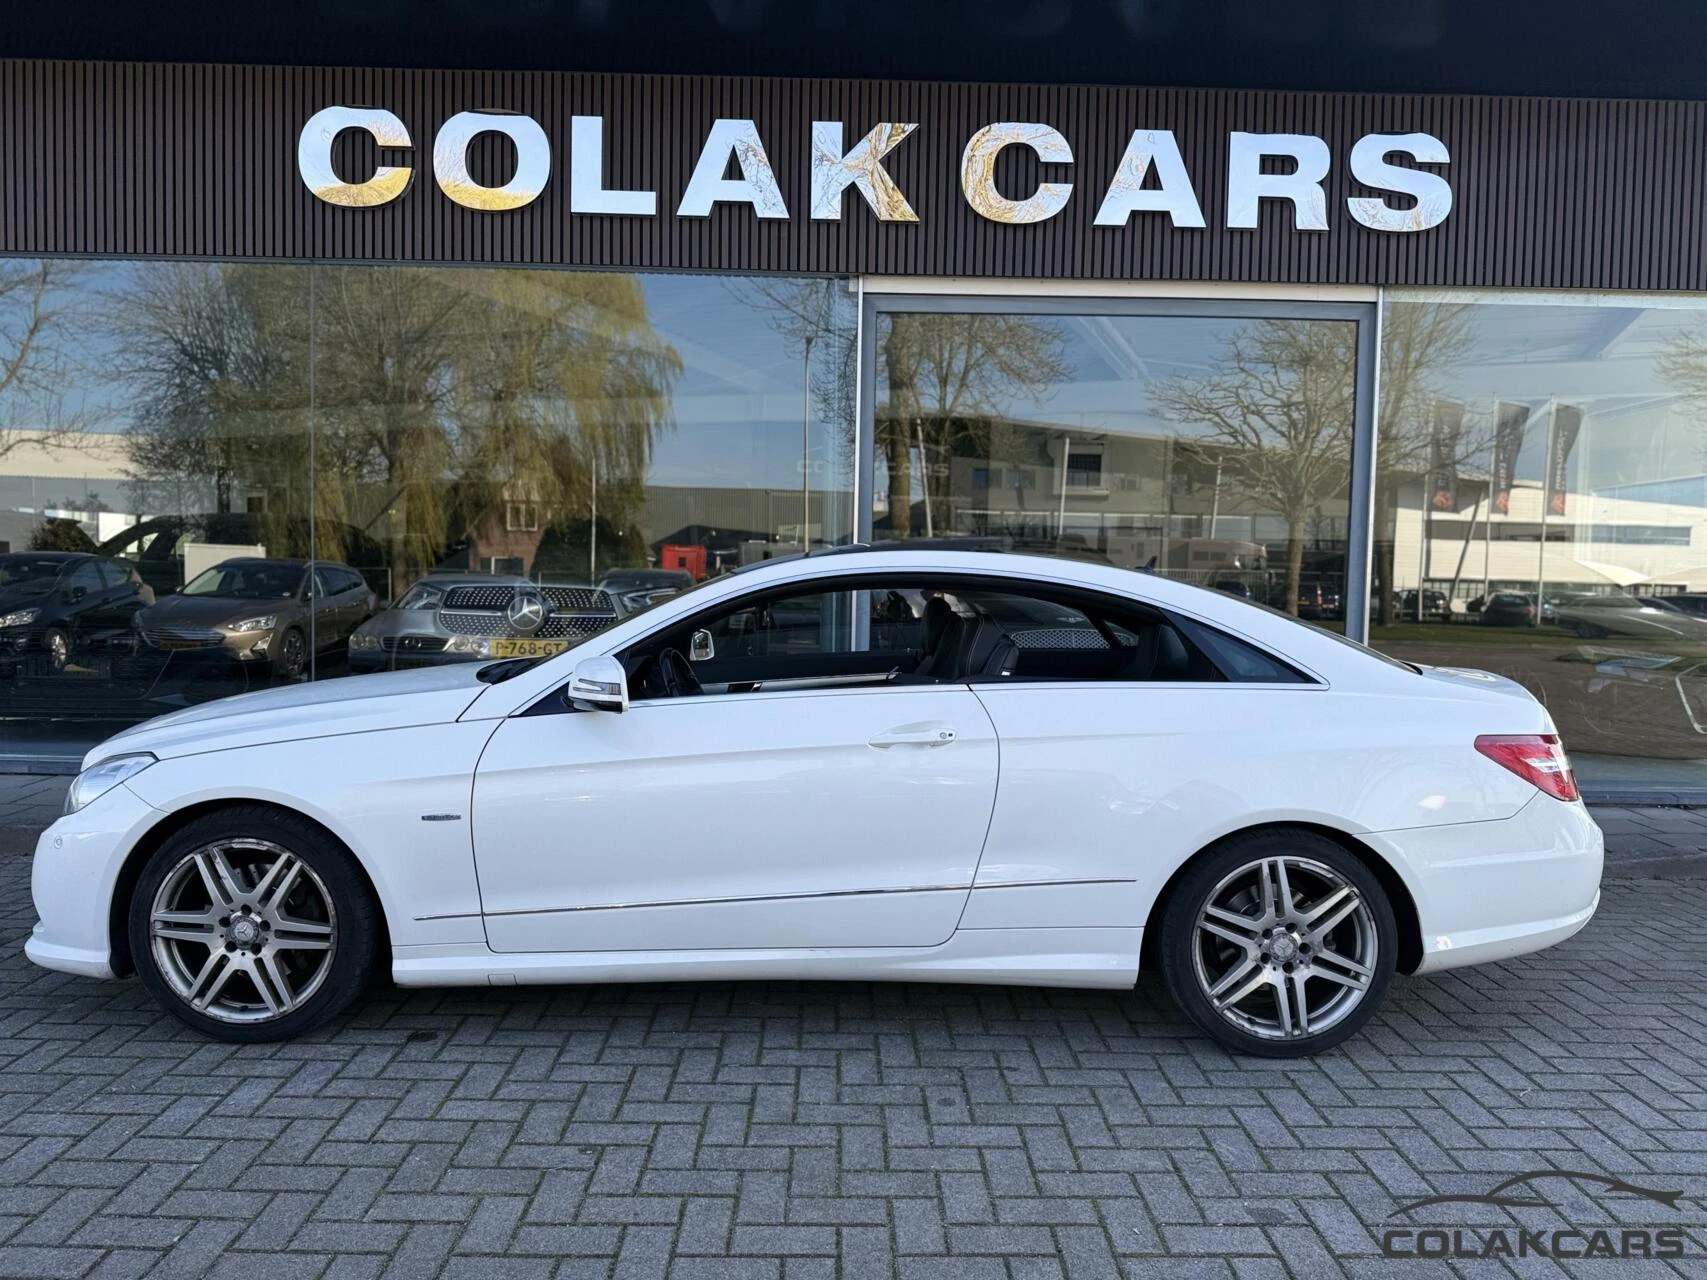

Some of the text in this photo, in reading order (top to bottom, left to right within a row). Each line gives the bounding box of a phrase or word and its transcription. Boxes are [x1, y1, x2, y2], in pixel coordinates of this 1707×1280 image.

[298, 105, 1453, 233] COLAK CARS
[496, 641, 562, 656] P-768-GT
